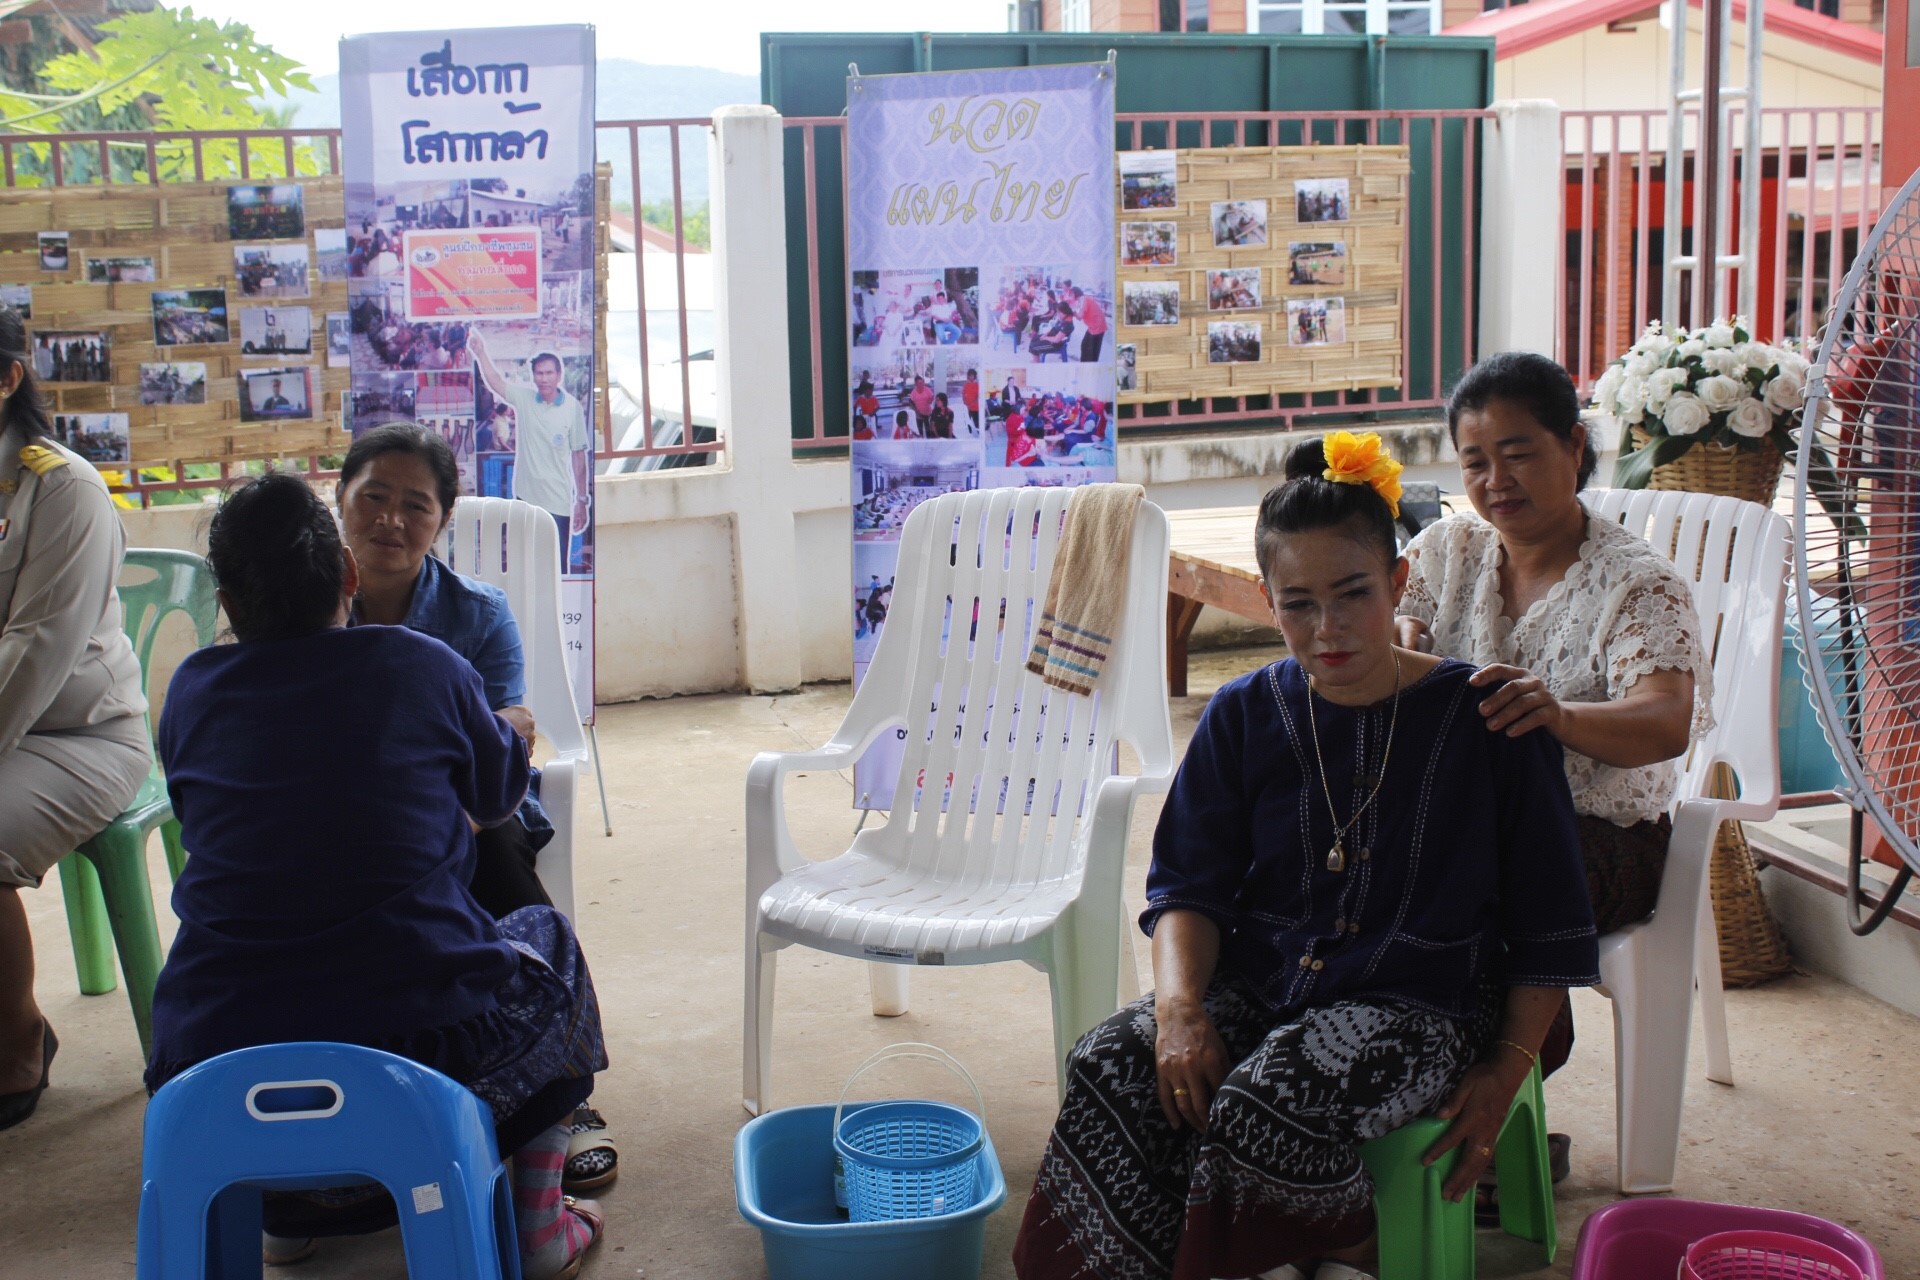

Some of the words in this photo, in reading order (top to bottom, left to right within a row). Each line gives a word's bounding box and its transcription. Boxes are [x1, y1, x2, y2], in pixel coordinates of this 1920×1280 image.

[407, 38, 529, 97] เสื่อกก
[400, 100, 549, 165] โสกกล้า
[924, 94, 1042, 154] นวด
[886, 160, 1090, 226] แผนไทย
[562, 612, 582, 625] 39
